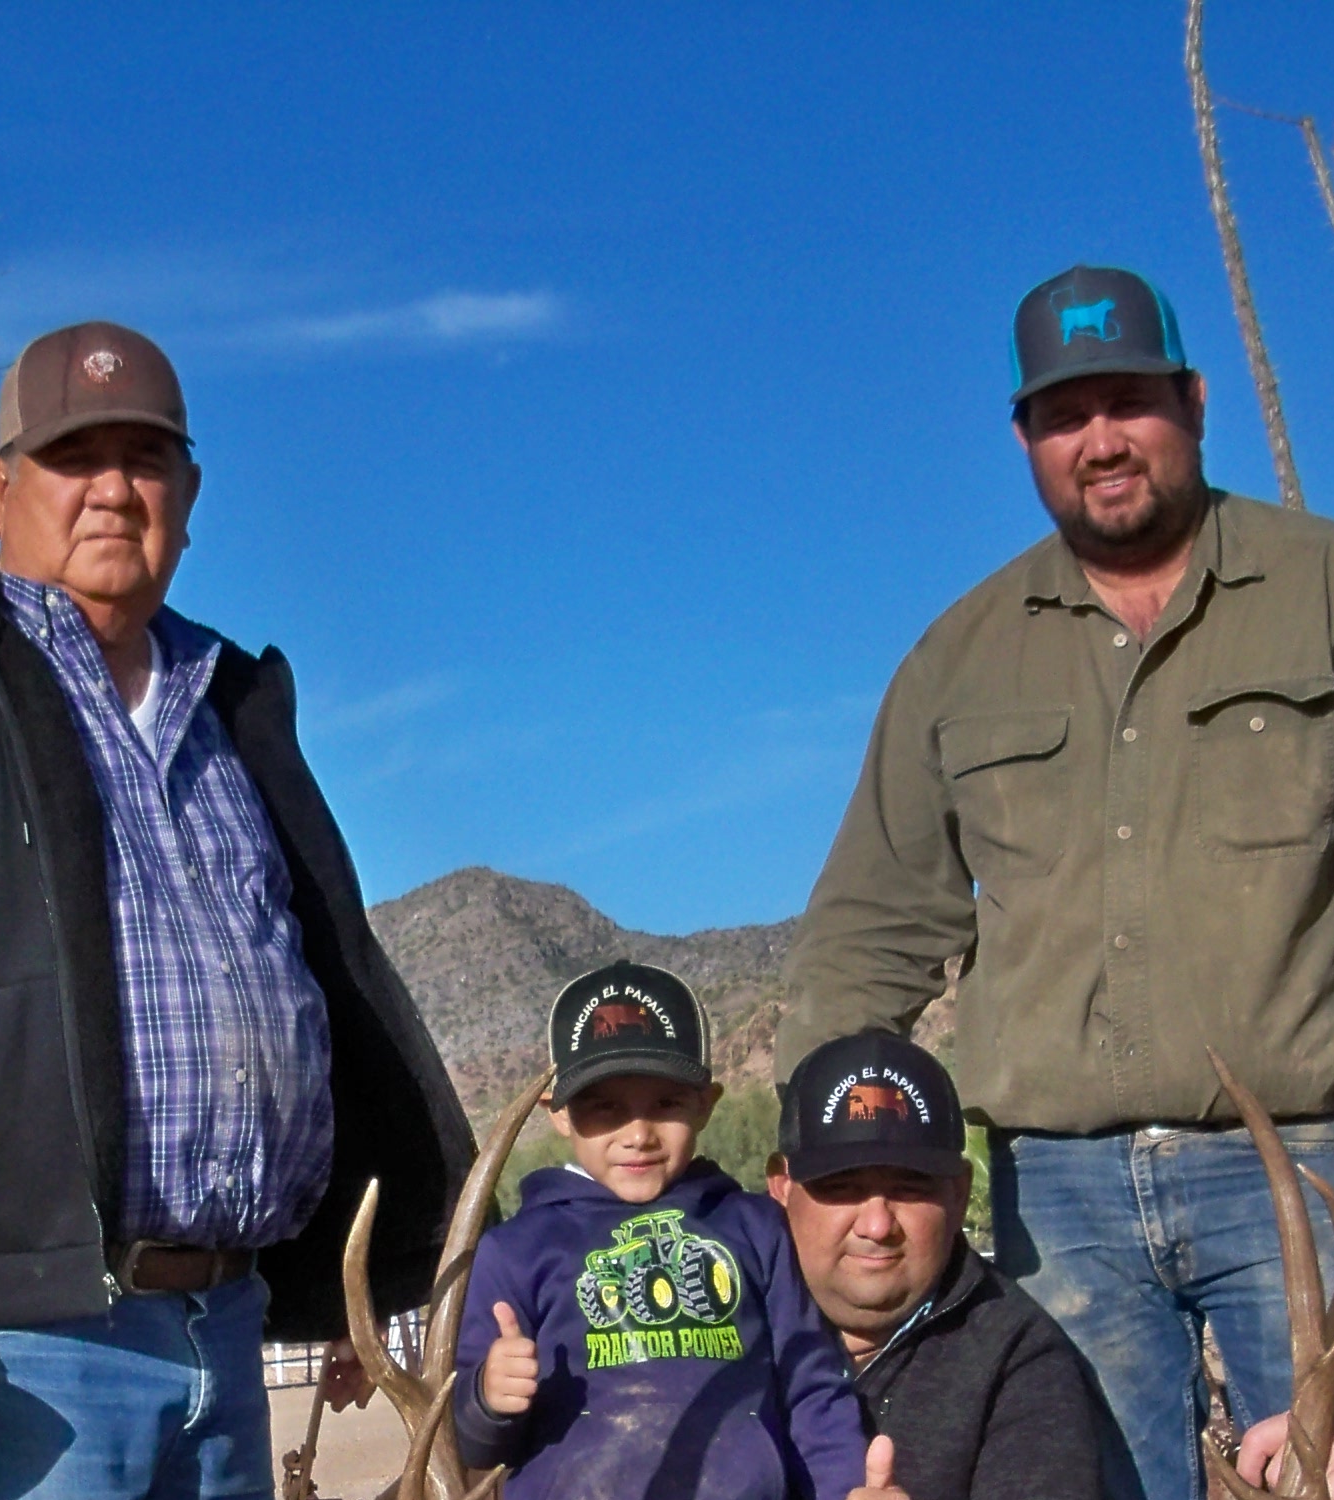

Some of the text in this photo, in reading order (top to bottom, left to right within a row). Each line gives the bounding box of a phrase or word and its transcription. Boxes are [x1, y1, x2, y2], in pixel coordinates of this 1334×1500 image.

[571, 985, 677, 1051] RANCHO EL PAPALOTE
[823, 1067, 930, 1124] RANCHO EL PAPALOTE
[587, 1326, 744, 1369] TRACTOR POWER
